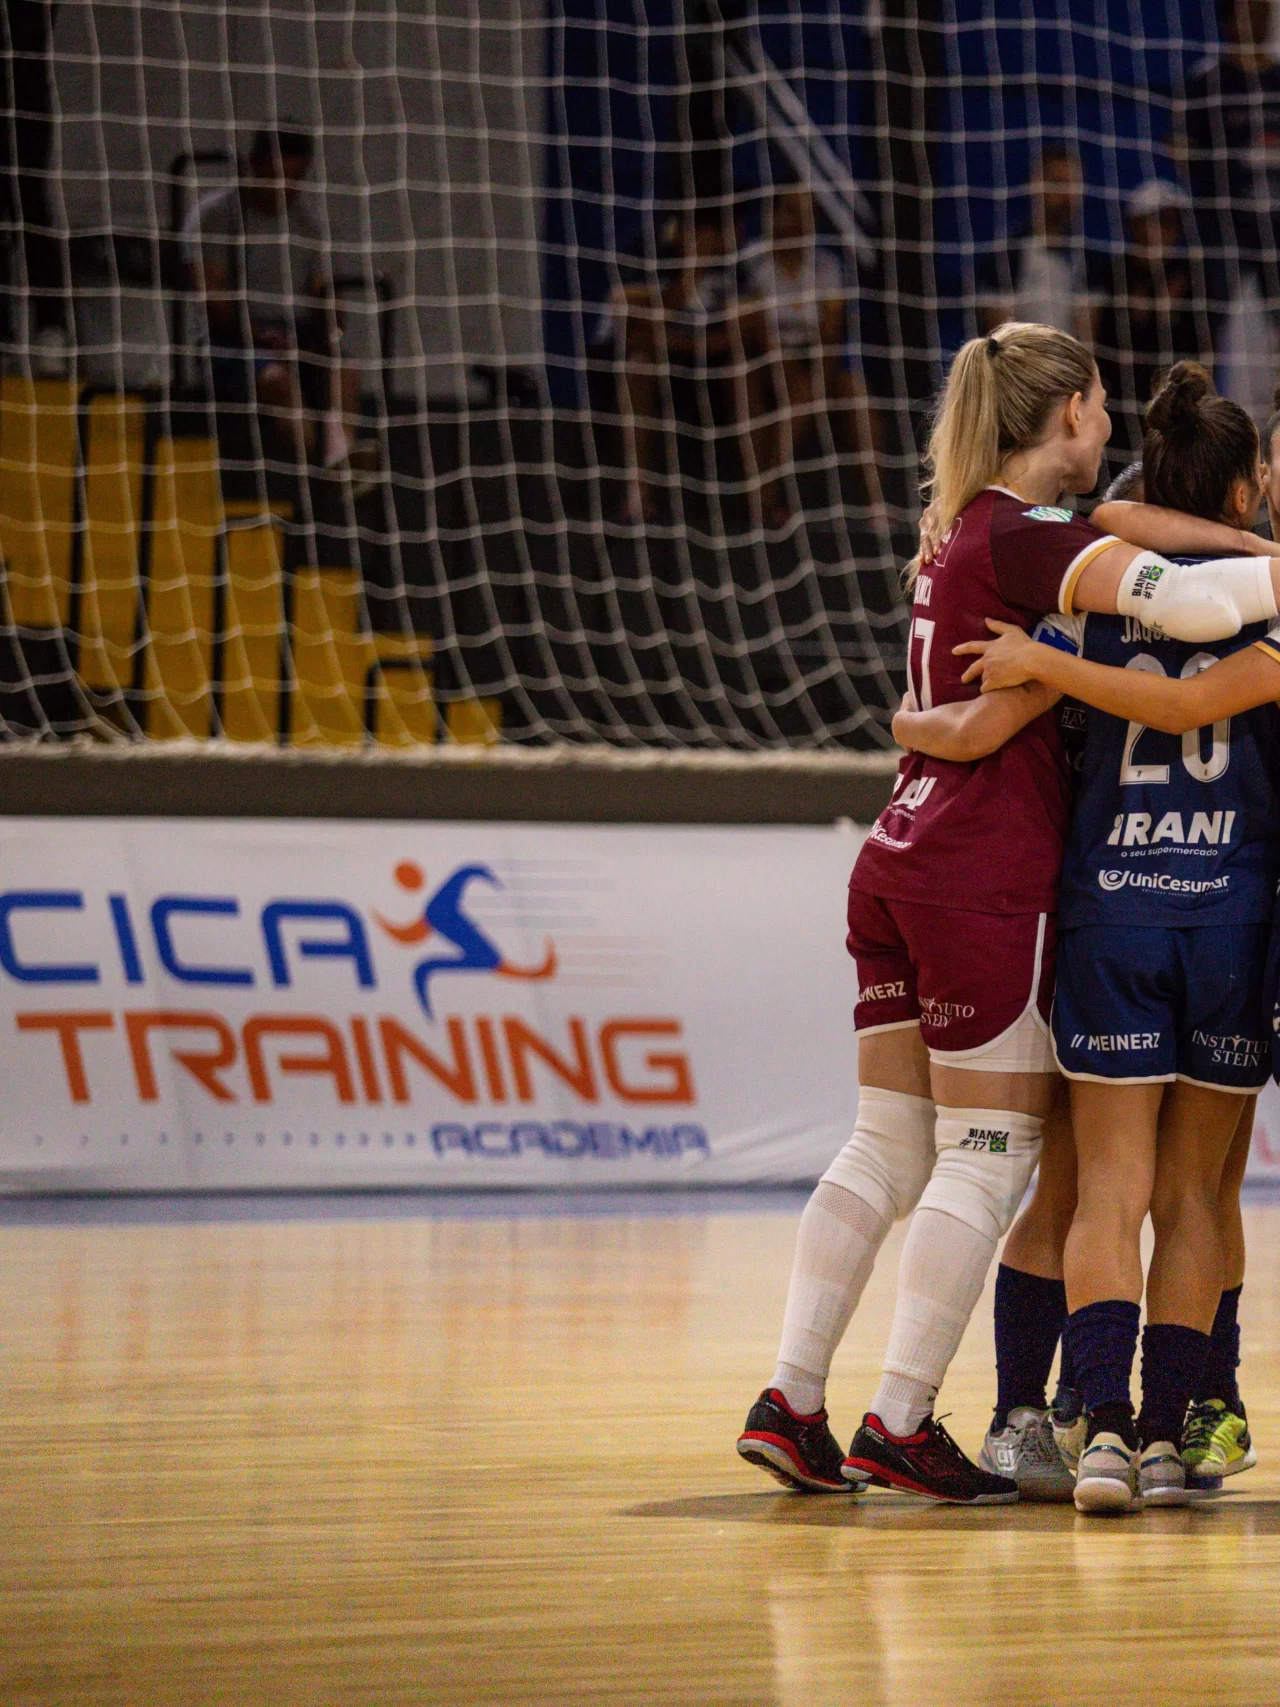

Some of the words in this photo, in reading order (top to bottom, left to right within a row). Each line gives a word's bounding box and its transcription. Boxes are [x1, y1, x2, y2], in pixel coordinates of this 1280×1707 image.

[1132, 565, 1152, 597] BIANCA
[1142, 581, 1156, 600] #17
[1119, 652, 1230, 786] 20
[1107, 810, 1236, 846] IRANI
[1148, 846, 1218, 857] supermercado
[1129, 872, 1230, 893] UniCesumar
[0, 888, 376, 989] CICA
[1087, 1032, 1161, 1051] MEINERZ
[15, 1011, 697, 1106] TRAINING
[1212, 1049, 1260, 1067] STEIN
[430, 1121, 711, 1159] ACADEMIA
[959, 1138, 986, 1151] #17
[969, 1128, 1010, 1142] BIANCA
